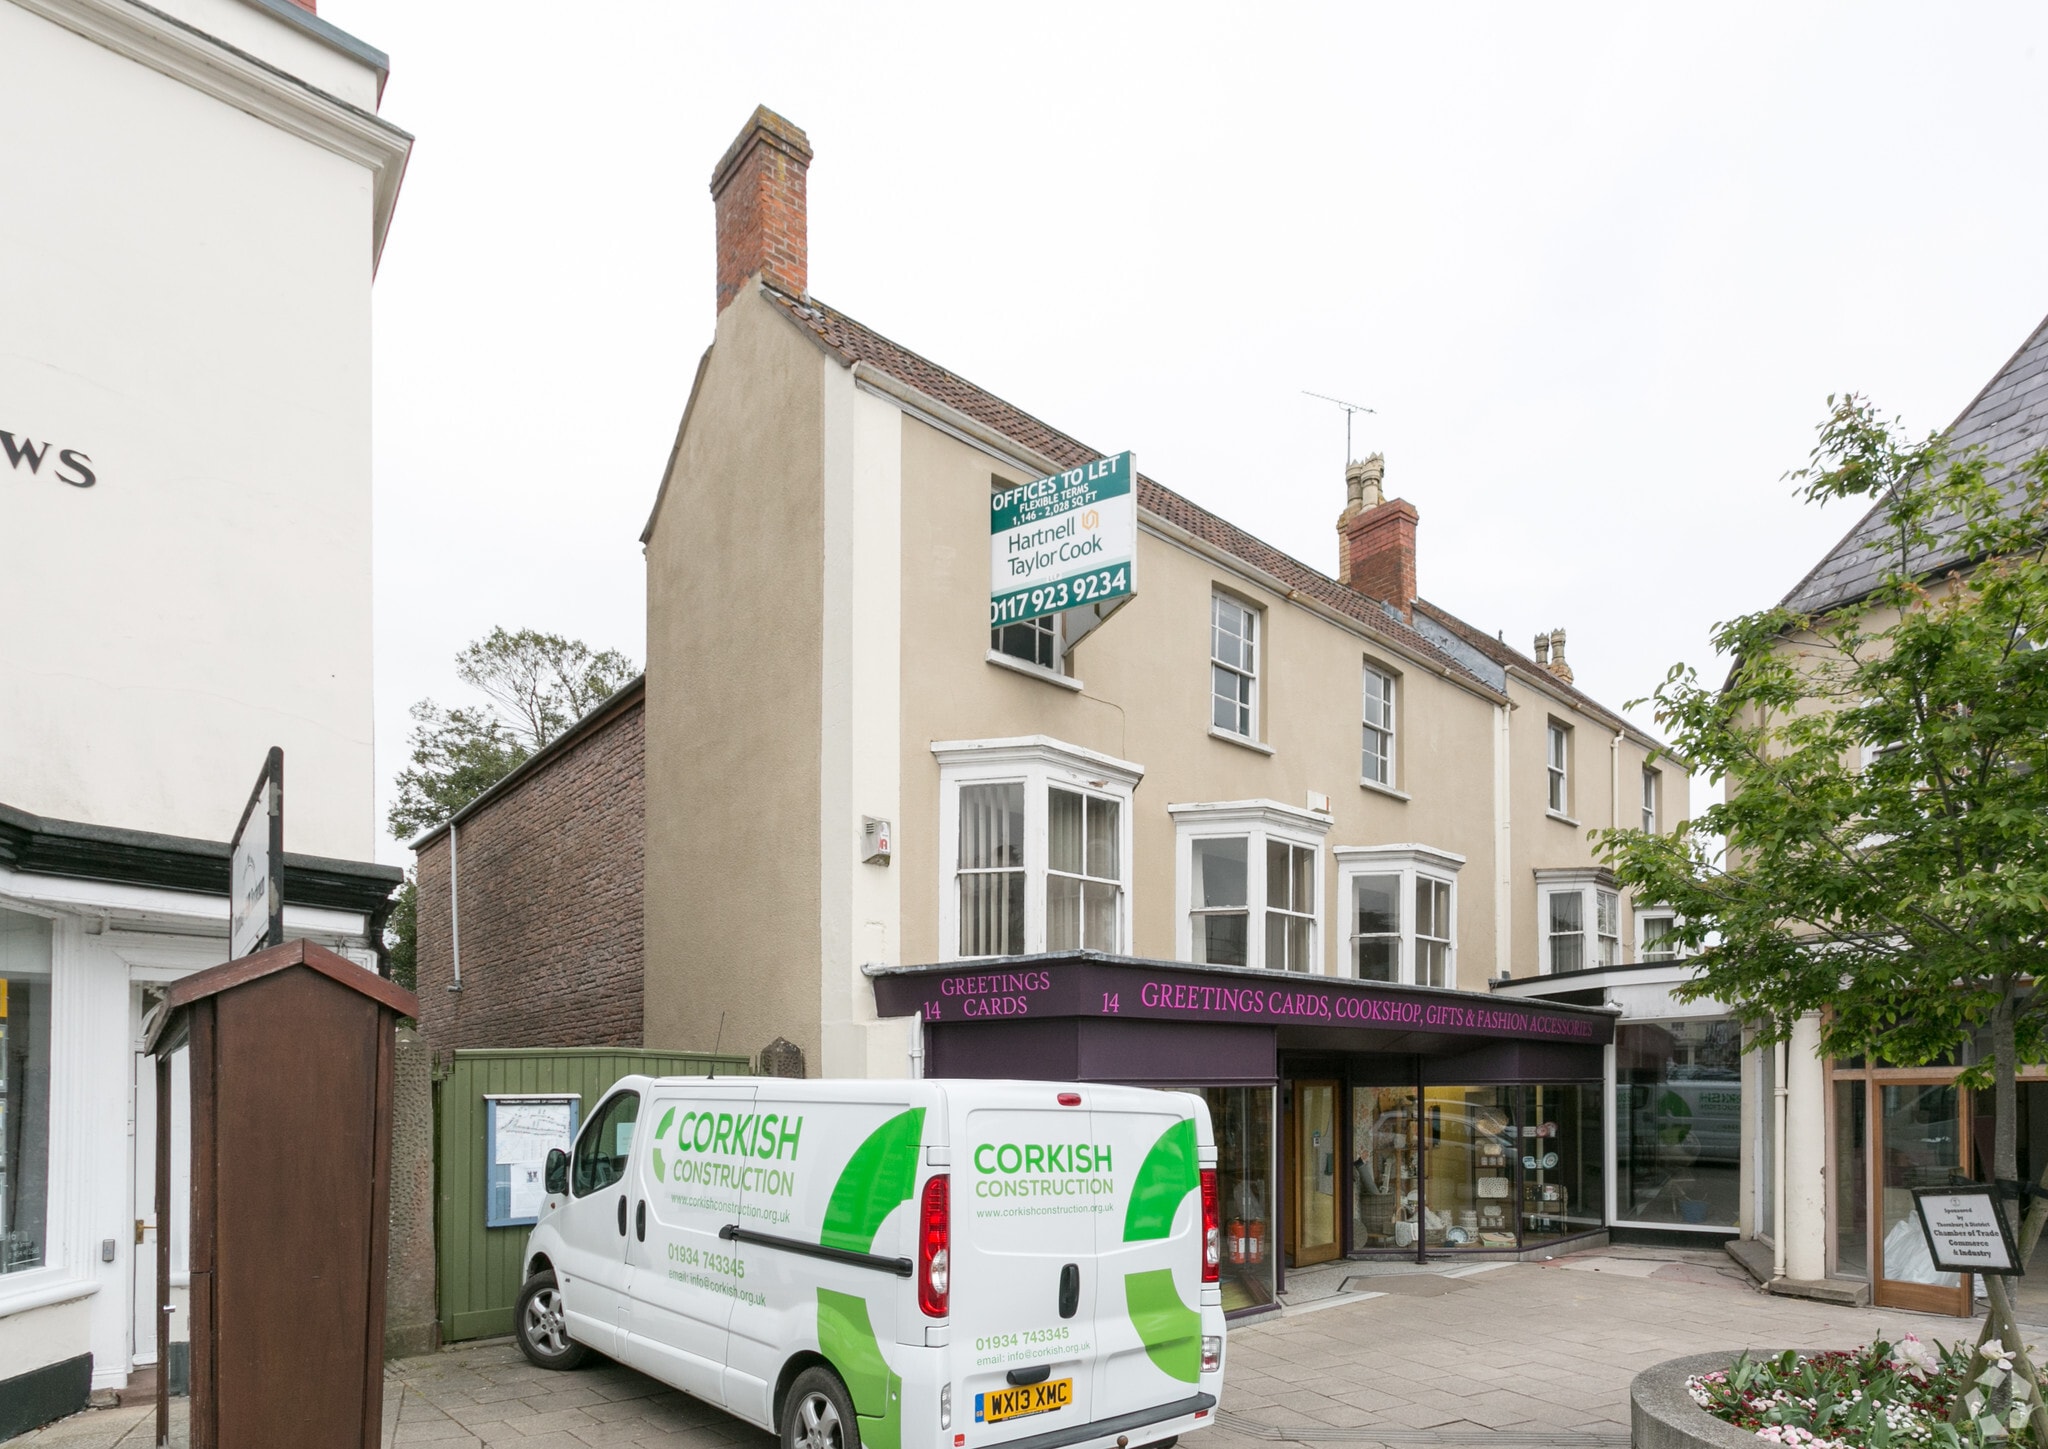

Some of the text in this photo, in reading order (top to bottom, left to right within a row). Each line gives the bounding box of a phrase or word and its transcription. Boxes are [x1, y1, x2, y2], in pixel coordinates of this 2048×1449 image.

[0, 430, 96, 488] WS
[992, 455, 1120, 511] OFFICES TO LET
[1019, 483, 1089, 513] FLEXIBLE TERMS
[1012, 511, 1037, 526] 1,146
[1045, 501, 1070, 517] 2,028
[1071, 496, 1084, 508] SQ
[1086, 490, 1098, 503] FT
[1009, 516, 1075, 554] Hartnell
[1008, 534, 1103, 578] Taylor Cook
[991, 567, 1126, 623] 0117 923 9234
[941, 971, 1050, 996] GREETINGS
[923, 995, 1028, 1020] 14 CARDS
[1102, 982, 1593, 1037] 14 GREETINGS CARDS, COOKSHOP, GIFTS & FASHION ACCESSORIES
[678, 1111, 803, 1161] CORKISH
[974, 1143, 1113, 1175] CORKISH
[673, 1158, 794, 1197] CONSTRUCTION
[975, 1178, 1114, 1198] CONSTRUCTION
[671, 1193, 790, 1224] www.corkishconstruction.org.uk
[976, 1203, 1114, 1218] www.corkishconstruction.org.uk
[1933, 1229, 2000, 1237] Chamber of Trade
[1948, 1239, 1990, 1247] Commerce
[668, 1243, 745, 1279] 01934 743345
[1959, 1249, 1991, 1258] Industry
[669, 1269, 766, 1307] email: info@corkish.org.uk
[976, 1326, 1070, 1351] 01934 743345
[976, 1341, 1091, 1366] email: info@corkish.org.uk
[992, 1382, 1067, 1416] WX13 XMC
